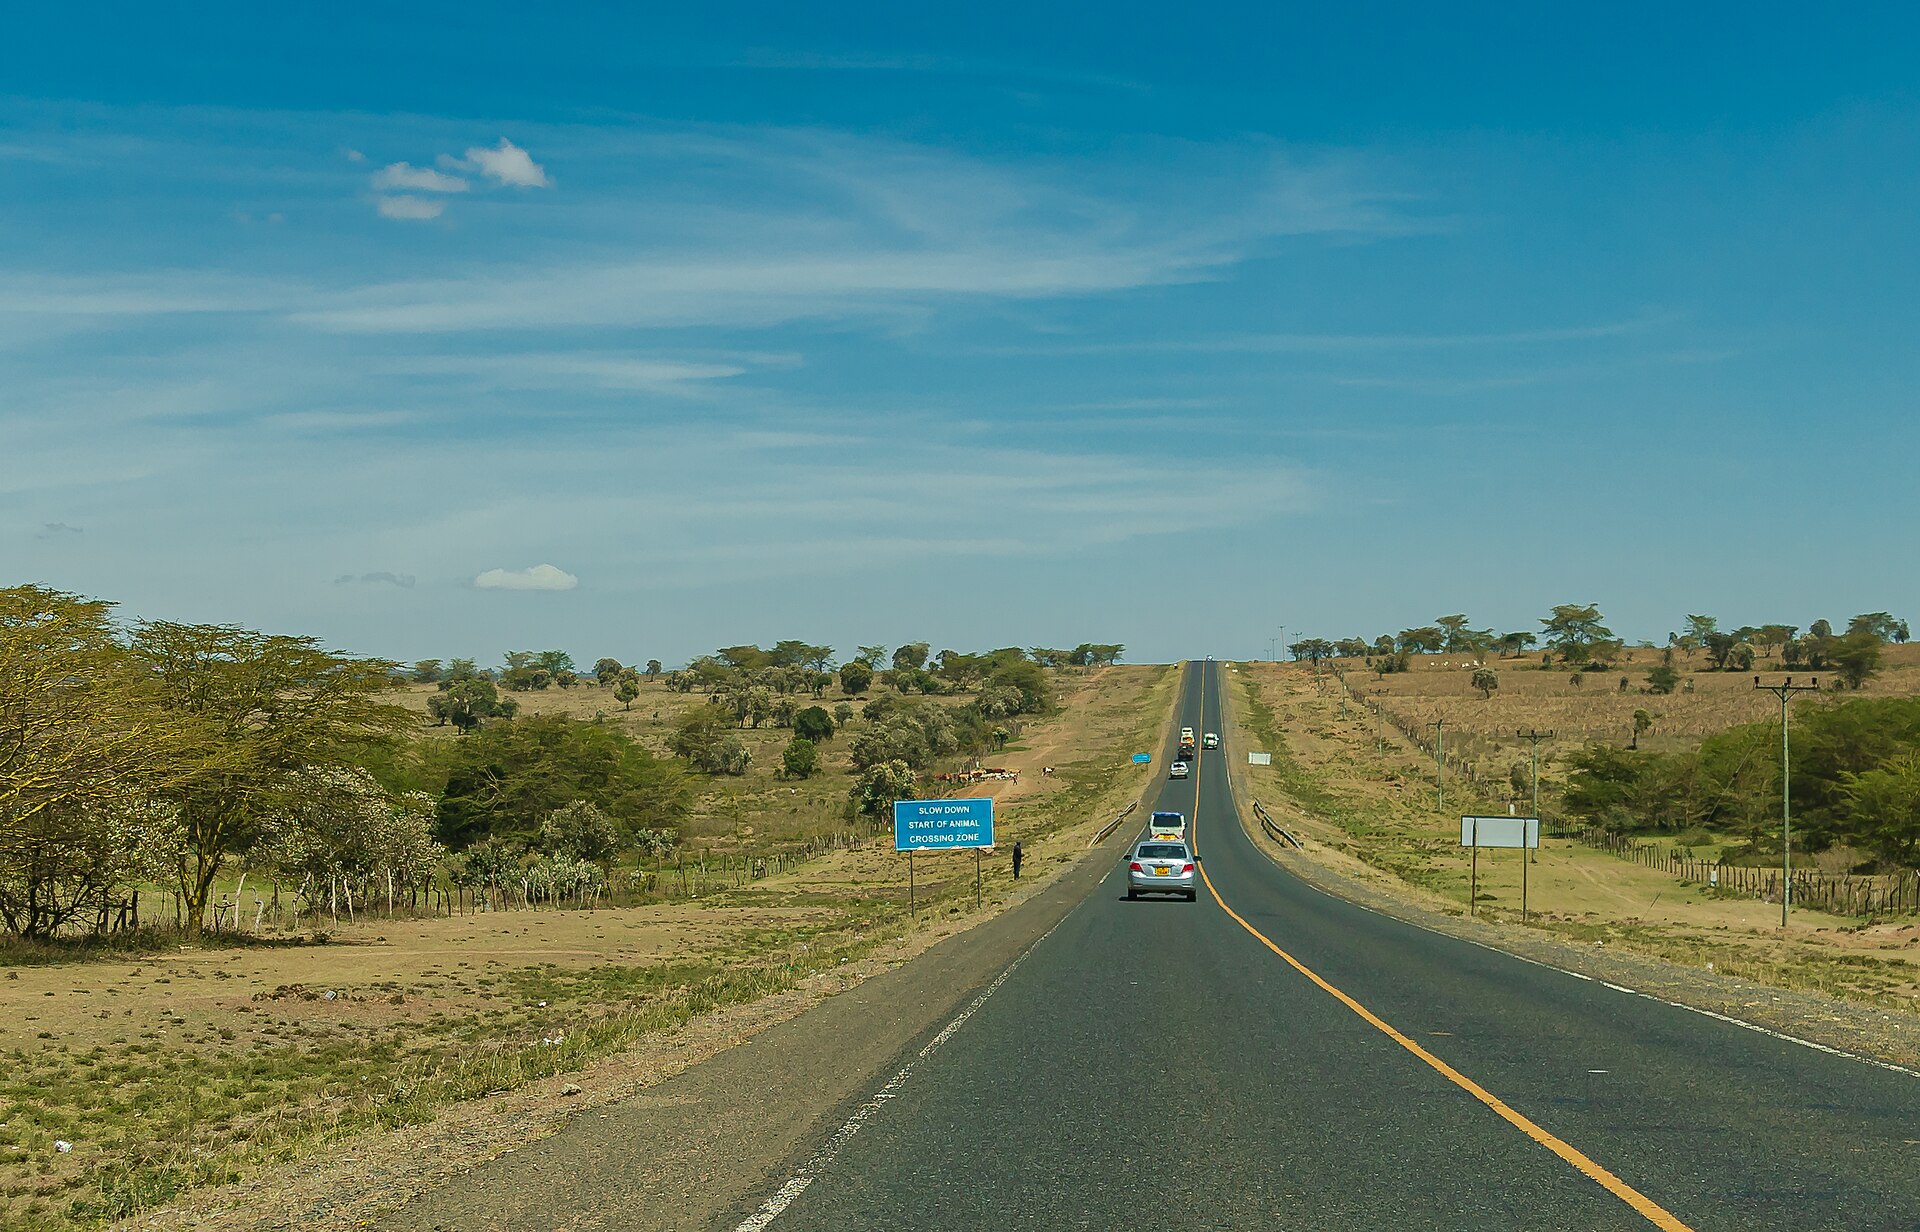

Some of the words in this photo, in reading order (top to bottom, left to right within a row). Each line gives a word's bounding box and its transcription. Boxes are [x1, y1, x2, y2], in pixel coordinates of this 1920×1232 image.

[945, 806, 970, 814] DOWN
[908, 821, 935, 829] START
[909, 835, 954, 843] CROSSING
[956, 833, 979, 841] ZONE
